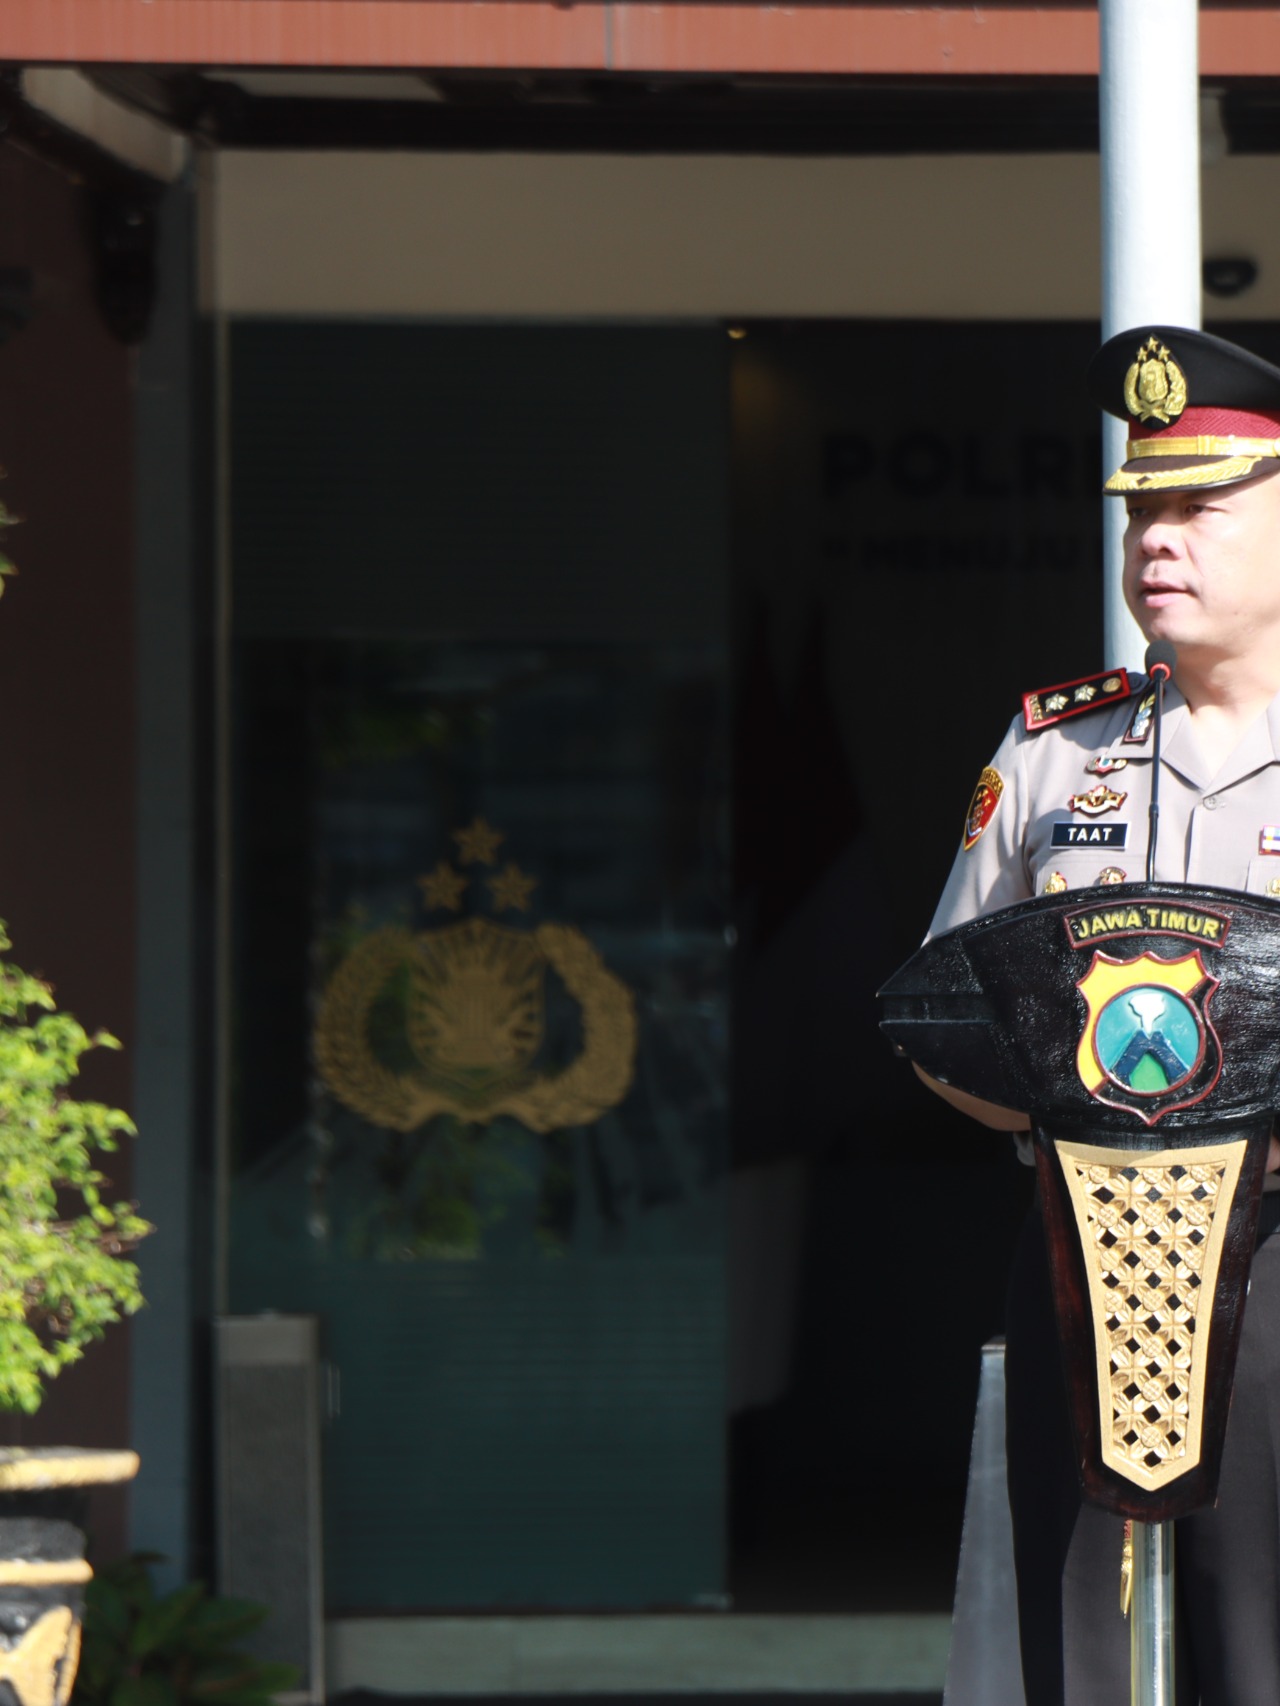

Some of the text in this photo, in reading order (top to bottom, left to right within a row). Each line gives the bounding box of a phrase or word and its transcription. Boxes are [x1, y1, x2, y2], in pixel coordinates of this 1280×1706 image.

[822, 431, 1101, 498] POLR
[1067, 827, 1113, 842] TAAT
[1078, 908, 1220, 939] JAWA TIMUR
